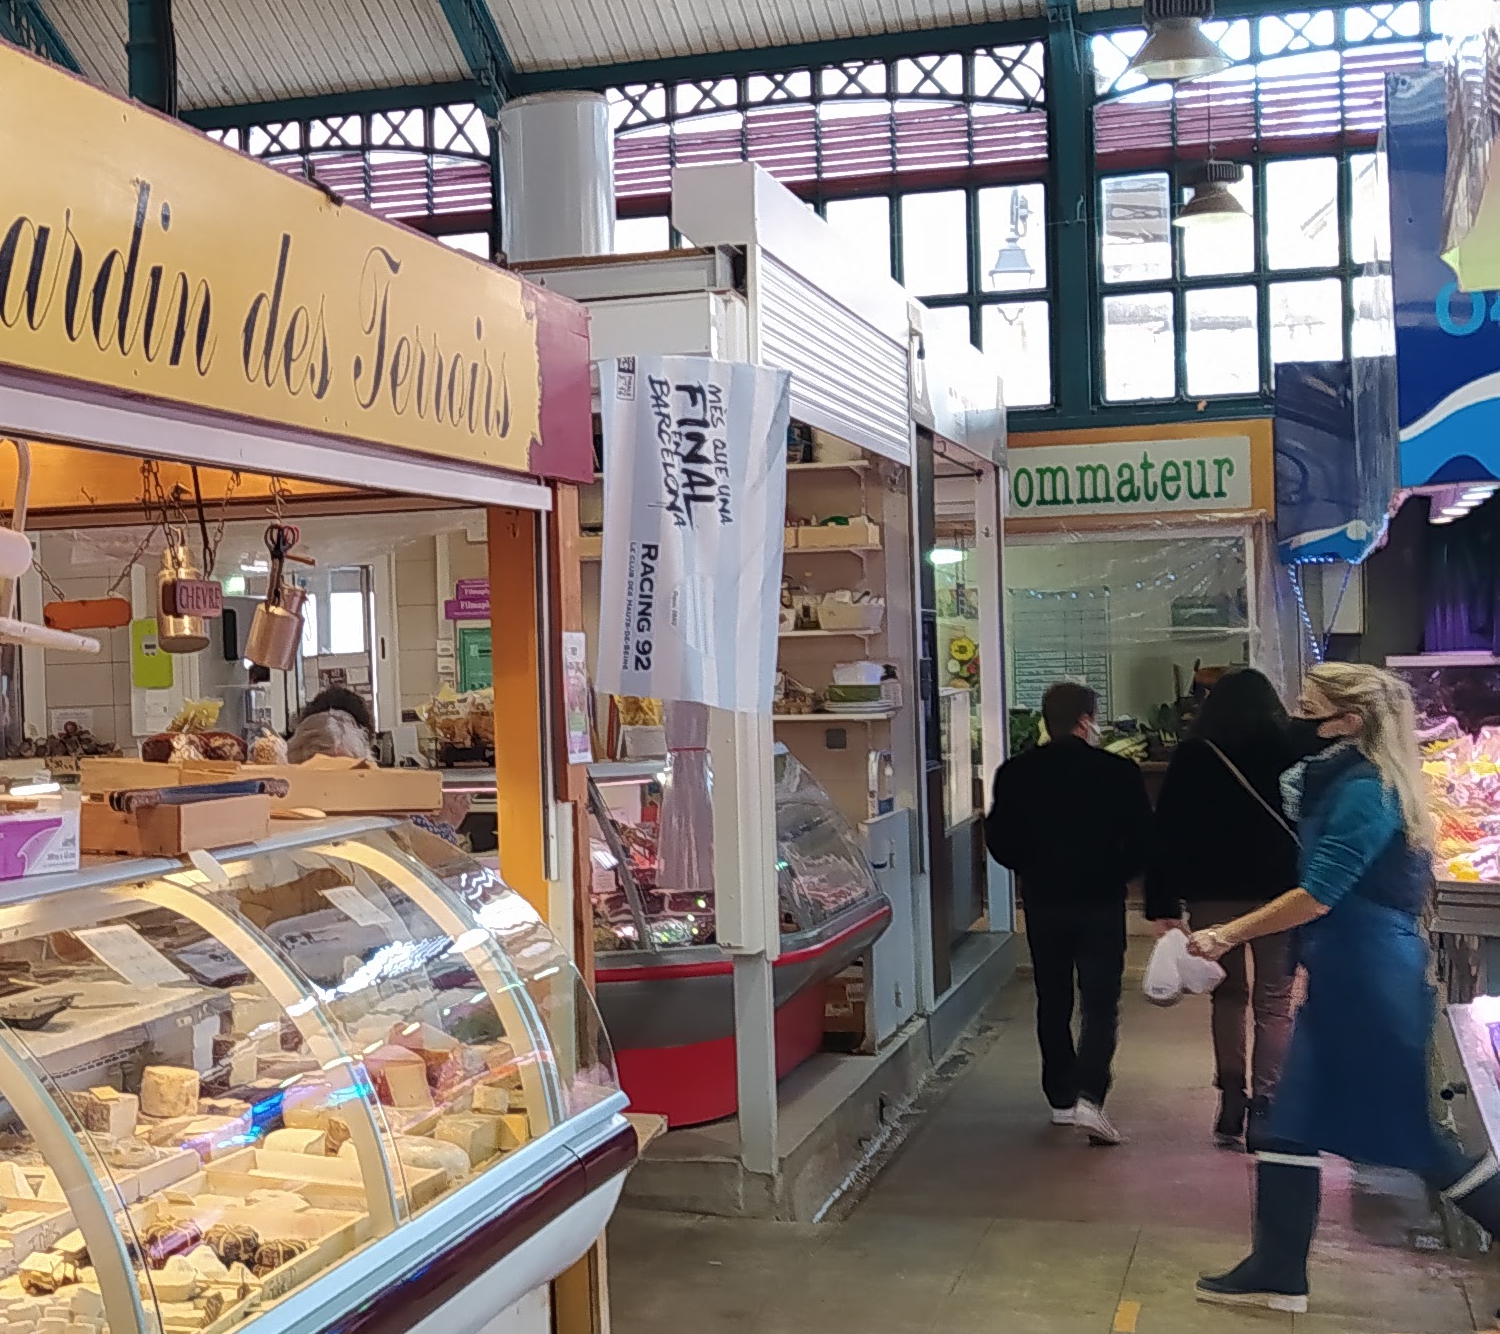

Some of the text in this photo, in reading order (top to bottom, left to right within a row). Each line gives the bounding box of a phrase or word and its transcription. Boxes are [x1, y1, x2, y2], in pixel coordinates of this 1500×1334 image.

[241, 232, 332, 400] des
[352, 246, 513, 439] Terroirs
[647, 374, 687, 528] BARCELONA
[671, 430, 685, 460] EN
[674, 381, 718, 531] FINAL
[712, 438, 729, 480] QUE
[1007, 450, 1235, 508] ommateur
[717, 484, 734, 526] UNA
[634, 543, 659, 672] RACING 92
